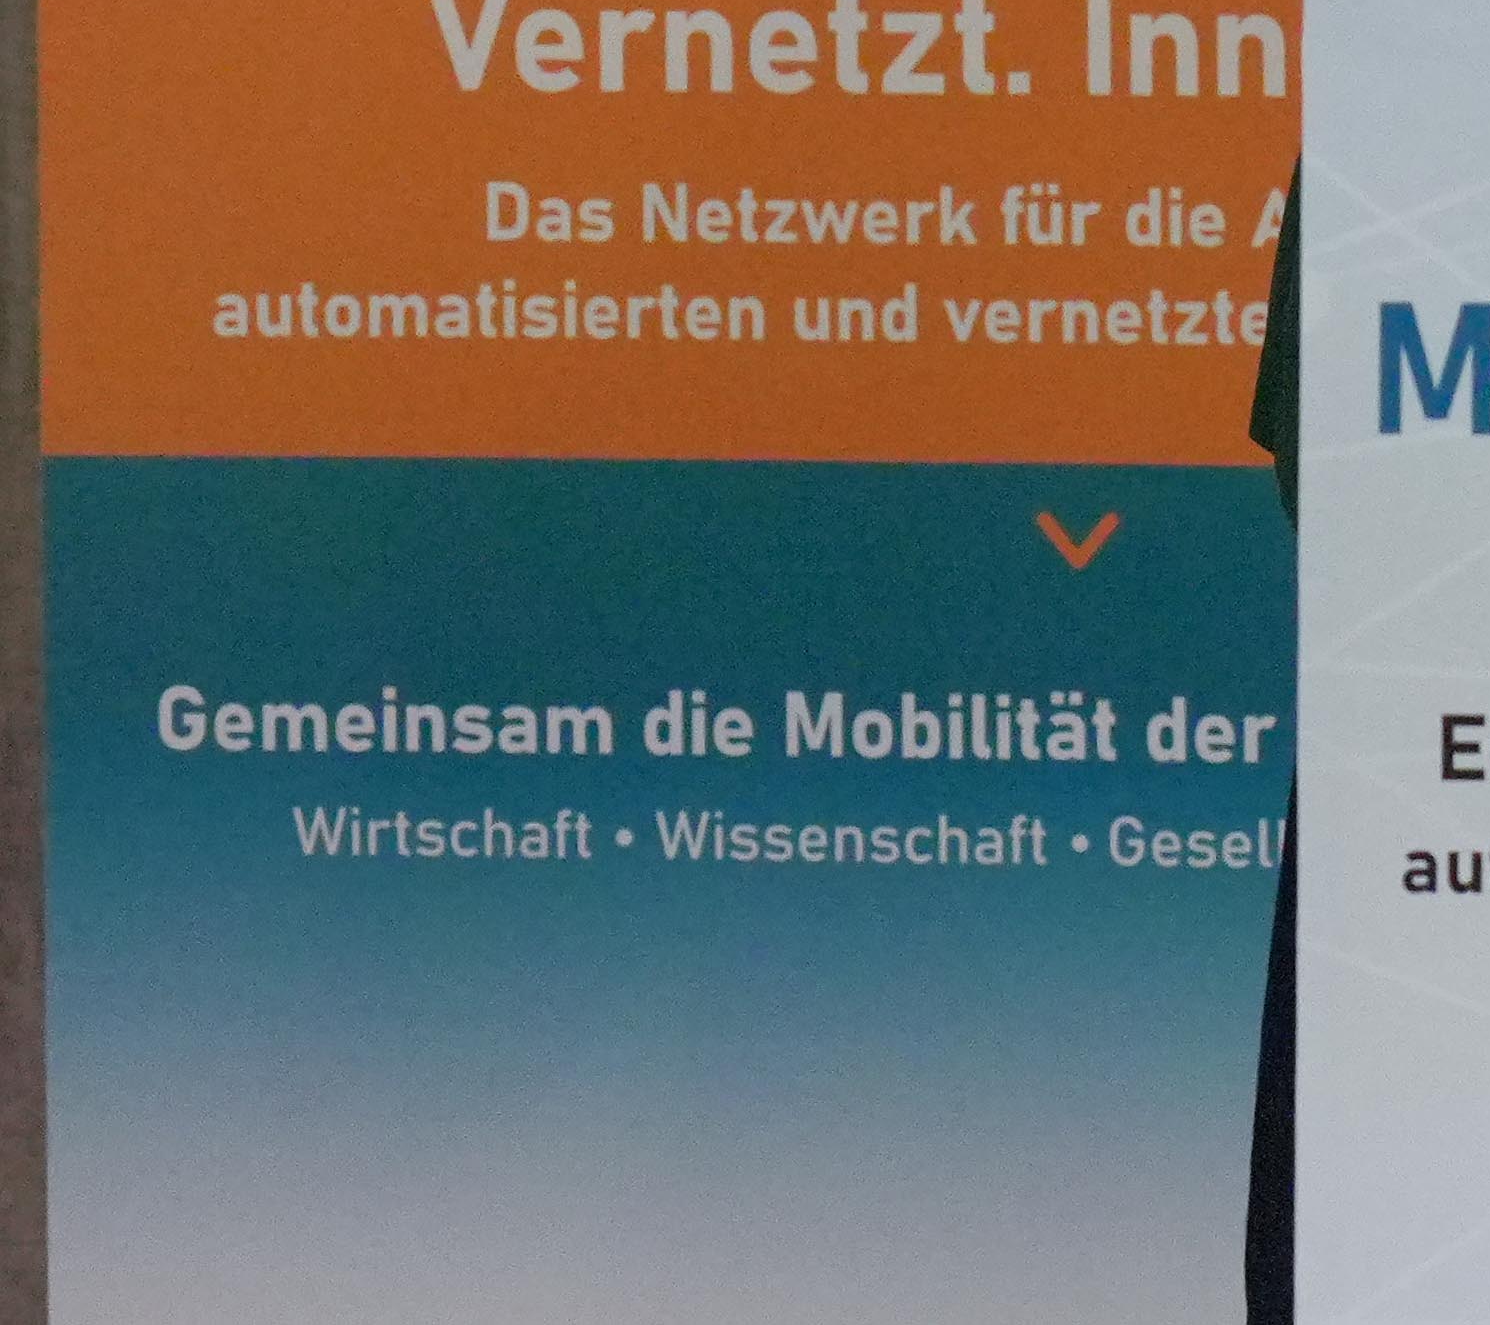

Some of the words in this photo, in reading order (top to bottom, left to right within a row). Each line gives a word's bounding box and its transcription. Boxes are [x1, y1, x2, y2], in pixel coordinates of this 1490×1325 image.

[487, 182, 614, 241] Das
[643, 183, 976, 244] Netzwerk
[1002, 183, 1100, 245] für
[1127, 188, 1225, 247] die
[214, 279, 764, 339] automatisierten
[795, 283, 917, 341] und
[945, 290, 1262, 345] vernetzte
[159, 685, 612, 754] Gemeinsam
[644, 690, 753, 756] die
[787, 692, 1116, 760] Mobilität
[1147, 697, 1276, 763] der
[293, 807, 591, 858] Wirtschaft
[657, 811, 1046, 865] Wissenschaft
